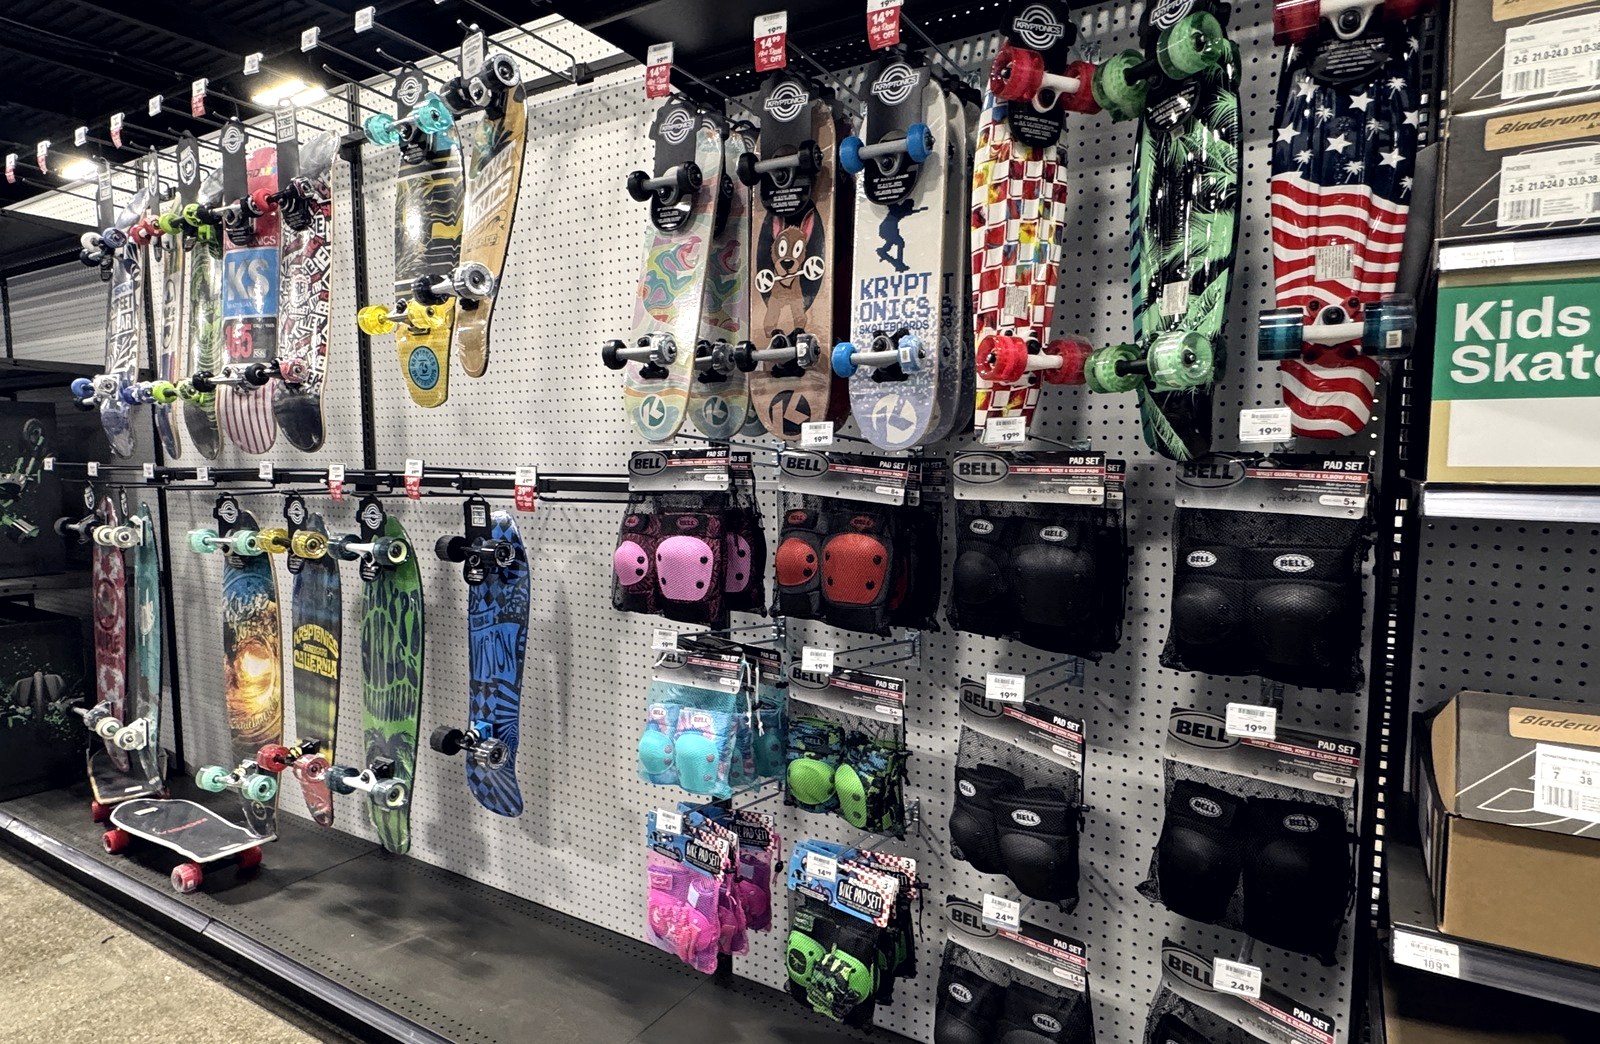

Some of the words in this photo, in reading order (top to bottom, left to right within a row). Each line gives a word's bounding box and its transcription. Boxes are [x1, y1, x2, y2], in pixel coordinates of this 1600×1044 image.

[882, 30, 895, 39] OFF
[1016, 21, 1062, 34] KRYPTONICS
[770, 54, 783, 63] OFF
[875, 76, 918, 91] KRYPTONICS
[766, 95, 808, 108] KRYPTONICS
[662, 121, 693, 132] KRYPTONICS
[860, 272, 932, 300] KRYPT
[859, 296, 931, 322] ONICS
[1454, 295, 1591, 343] Kids
[859, 319, 929, 335] SKATEBOARDS
[634, 458, 662, 470] BELL
[786, 457, 822, 472] BELL
[879, 461, 892, 469] PAD
[893, 462, 905, 470] SET
[1069, 456, 1084, 465] PAD
[1085, 456, 1100, 465] SET
[1323, 461, 1343, 471] PAD
[1345, 462, 1364, 471] SET
[959, 462, 1001, 475] BELL
[1107, 464, 1120, 472] SET
[1183, 463, 1234, 480] BELL
[1343, 498, 1357, 506] 5+
[973, 522, 989, 531] BELL
[1044, 530, 1064, 538] BELL
[1190, 555, 1210, 563] BELL
[293, 623, 339, 659] KRYPTONICS
[473, 629, 515, 679] VISION
[293, 649, 337, 680] CALIFORNIA
[792, 666, 824, 685] BELL
[875, 679, 887, 688] PAD
[888, 682, 899, 691] SET
[964, 690, 997, 713] BELL
[1053, 716, 1066, 727] PAD
[1066, 721, 1079, 732] SET
[1176, 720, 1229, 743] BELL
[1318, 741, 1336, 752] PAD
[1338, 744, 1355, 755] SET
[1335, 777, 1347, 785] 8+
[1553, 771, 1560, 780] 7
[1580, 776, 1593, 786] 38
[1194, 800, 1217, 813] BELL
[1016, 813, 1036, 822] BELL
[686, 843, 699, 860] BIKE
[699, 847, 709, 862] PAD
[709, 851, 720, 867] SET!
[839, 881, 853, 900] BIKE
[853, 887, 867, 905] PAD
[867, 893, 882, 911] SET!
[951, 908, 991, 933] BELL
[1053, 938, 1068, 950] PAD
[1068, 944, 1083, 956] SET
[1168, 953, 1213, 990] BELL
[1037, 1018, 1056, 1029] BELL
[1293, 1007, 1311, 1023] PAD
[1312, 1016, 1330, 1032] SET
